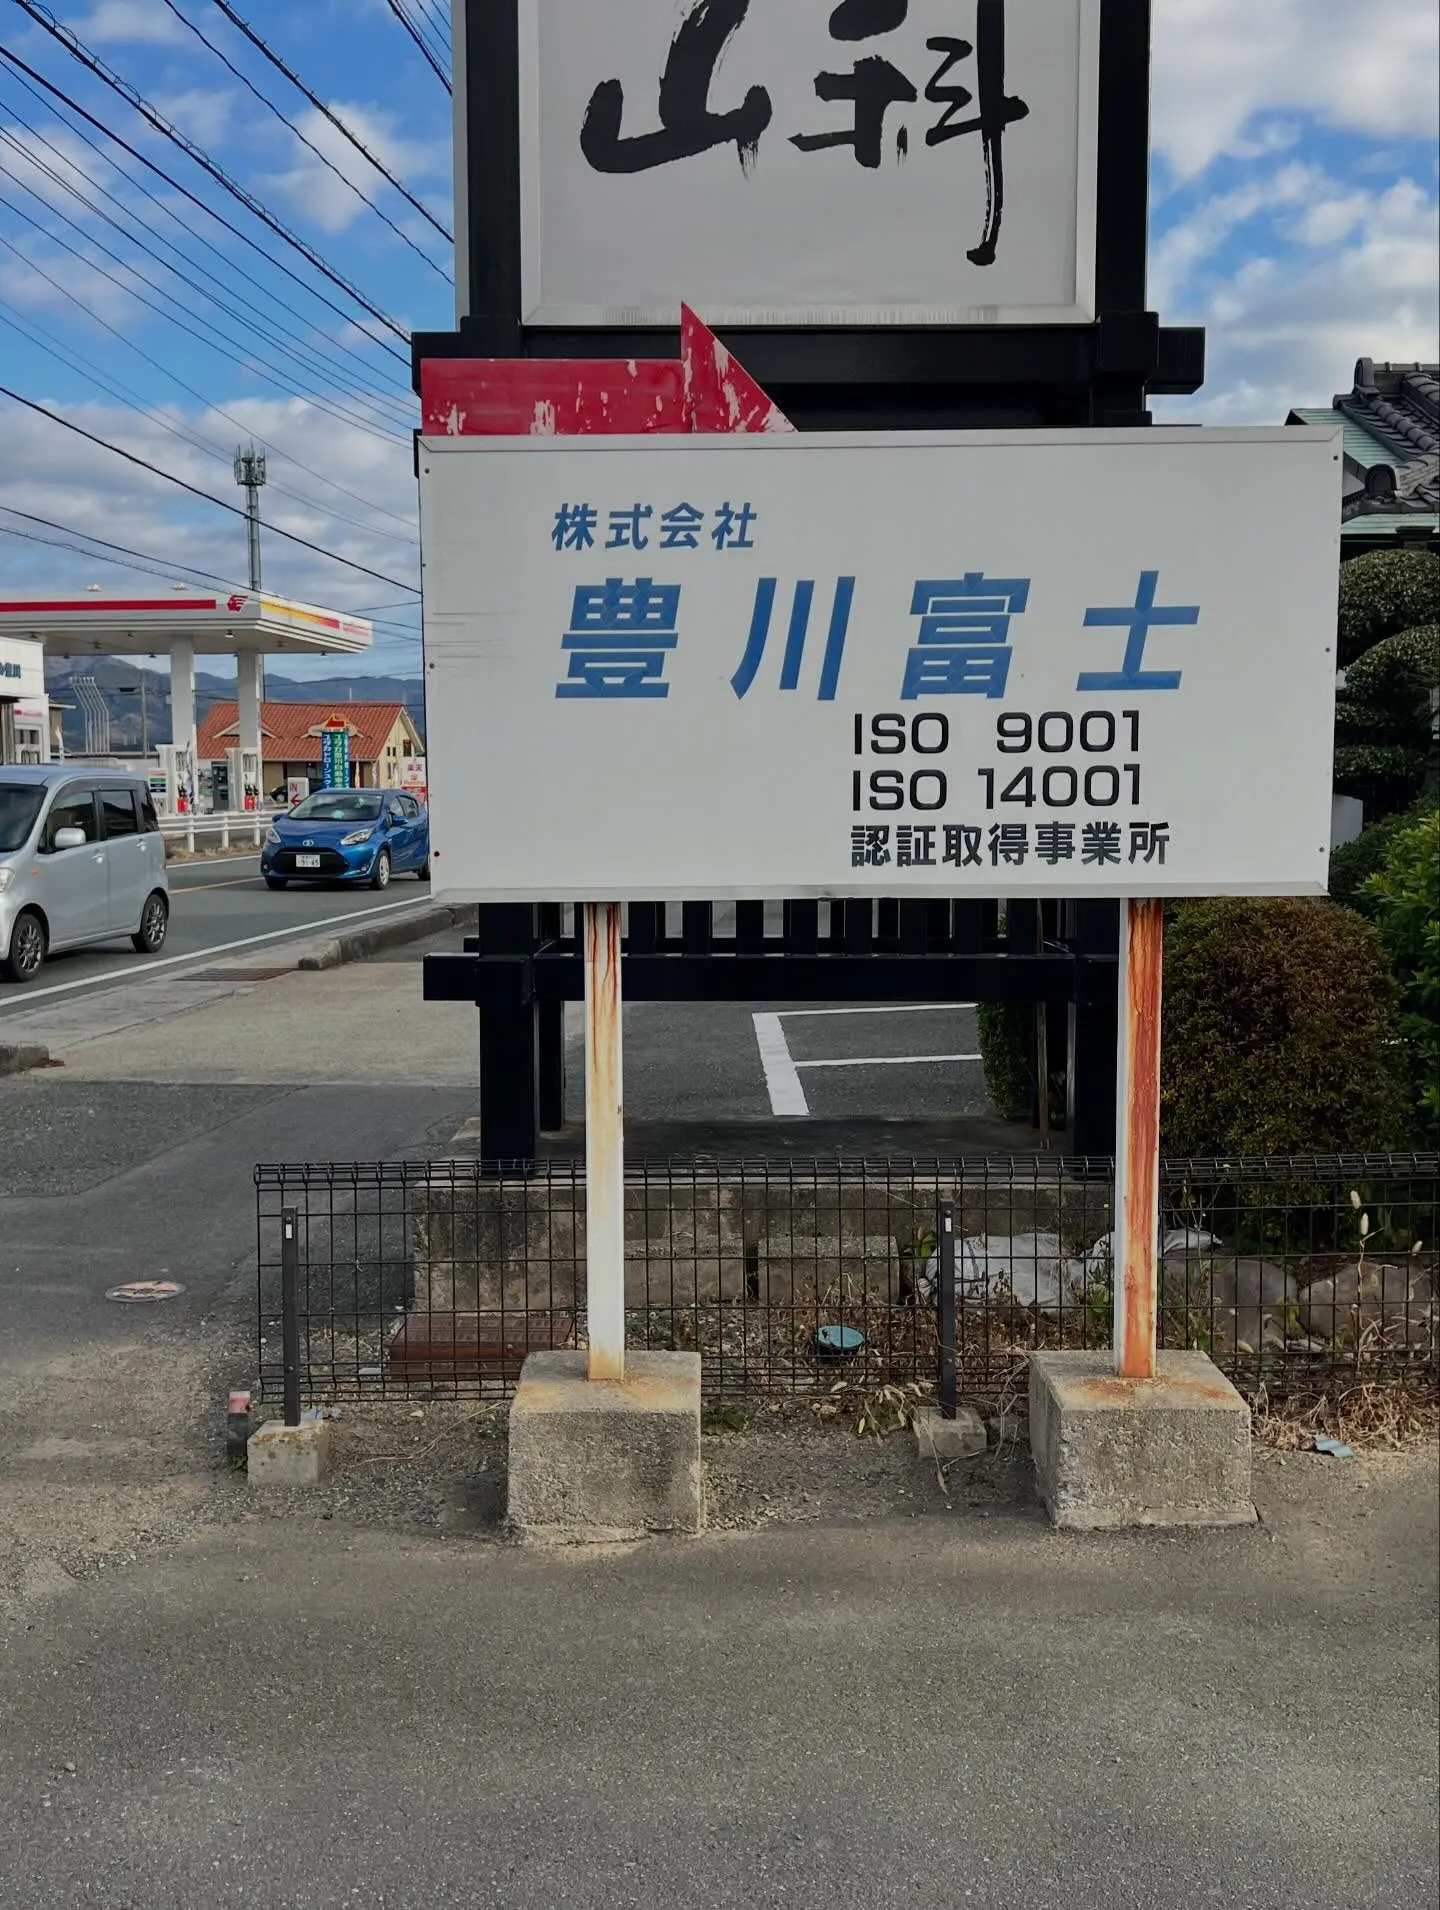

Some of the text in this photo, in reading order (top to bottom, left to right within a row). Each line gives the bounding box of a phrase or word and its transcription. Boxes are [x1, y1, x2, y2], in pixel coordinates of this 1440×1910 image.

[552, 501, 758, 551] 株式会社
[556, 571, 1200, 701] 豊川富士
[854, 710, 1140, 755] ISO 9001
[853, 763, 1141, 811] ISO 14001
[850, 820, 1170, 868] 認証取得事業所
